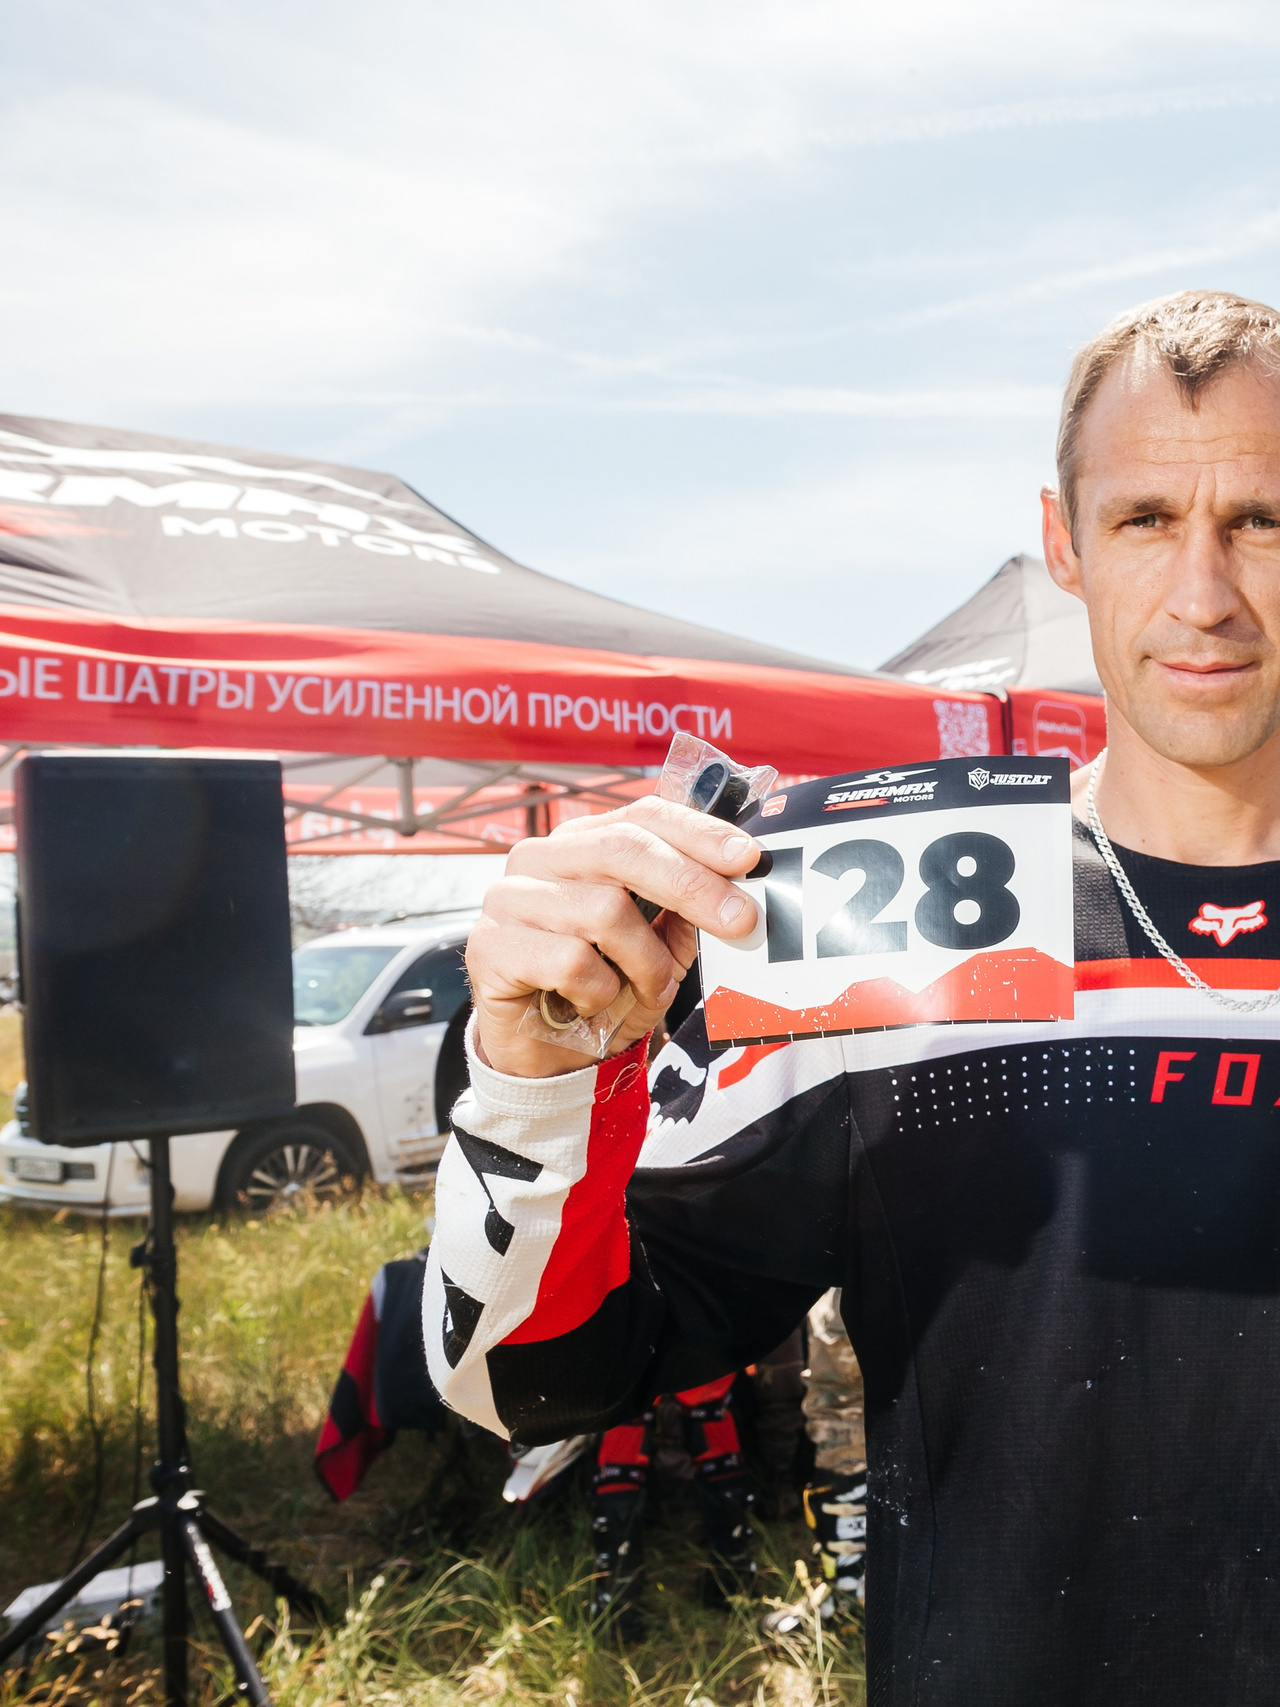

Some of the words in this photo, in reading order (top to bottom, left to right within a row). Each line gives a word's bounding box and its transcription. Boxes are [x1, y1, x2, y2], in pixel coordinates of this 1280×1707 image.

[76, 659, 255, 711] ШАТРЫ
[265, 671, 519, 728] УСИЛЕННОЙ
[527, 691, 733, 740] ПРОЧНОСТИ
[989, 773, 1053, 786] JUSTCAT
[823, 781, 939, 805] SHARMAX
[893, 793, 935, 804] MOTORS
[745, 831, 1021, 964] 128
